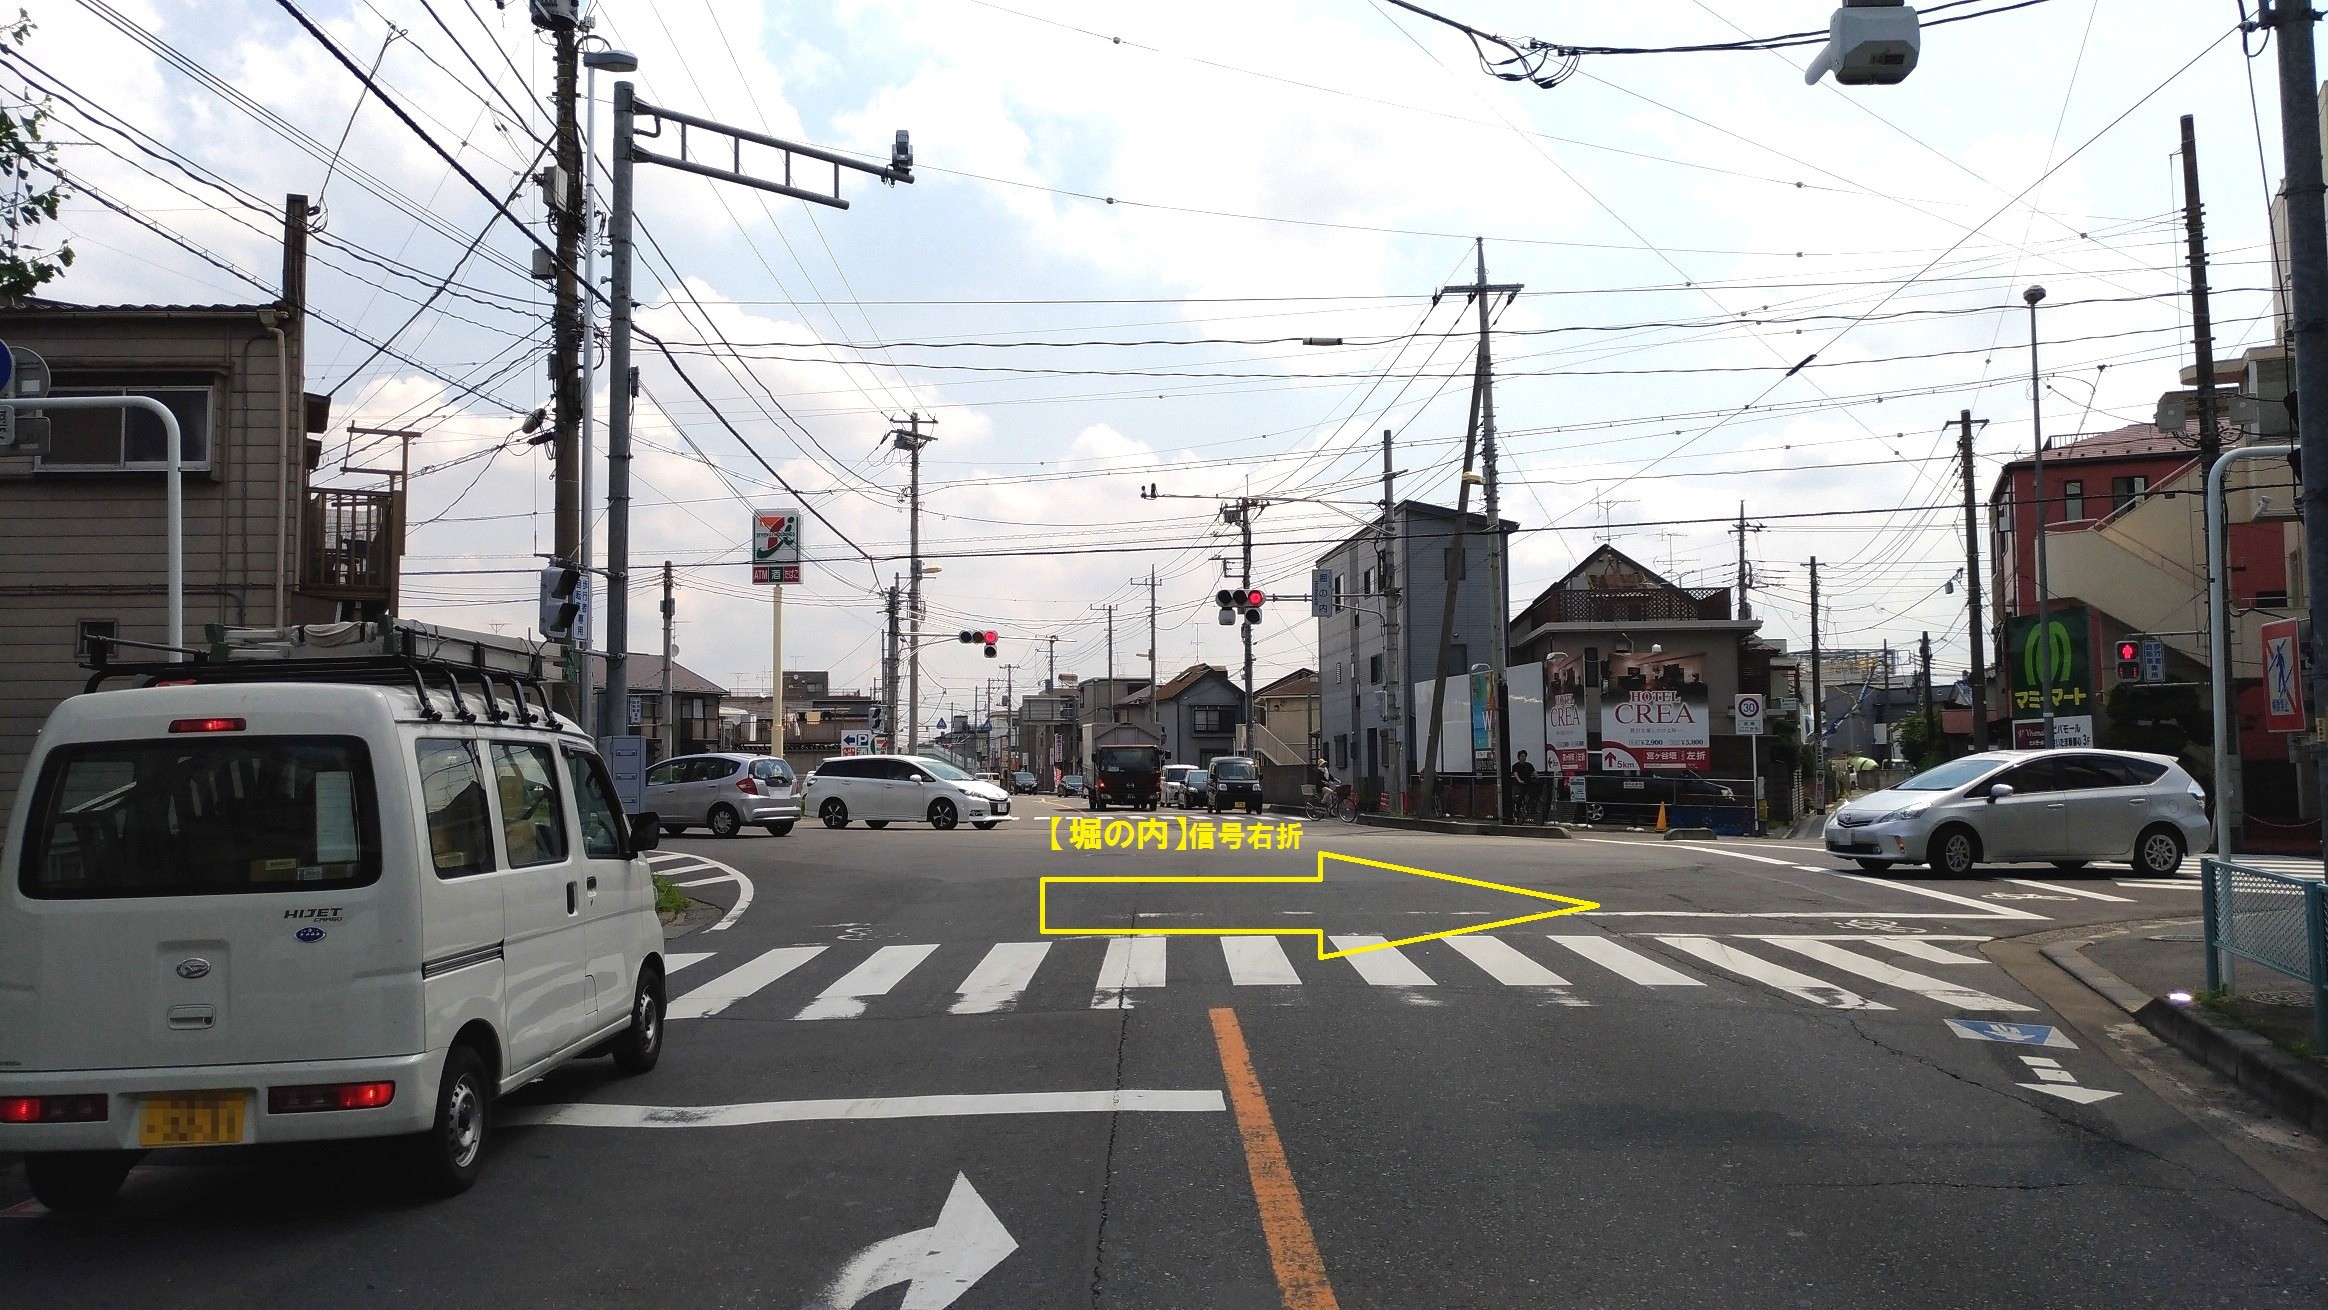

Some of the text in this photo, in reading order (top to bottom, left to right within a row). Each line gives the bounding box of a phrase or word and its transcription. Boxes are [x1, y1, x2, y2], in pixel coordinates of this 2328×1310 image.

[754, 569, 768, 580] ATM
[771, 569, 781, 580] 酒
[784, 569, 799, 579] たばこ
[1319, 573, 1328, 613] 堀の内
[577, 614, 584, 636] 専用
[1629, 690, 1682, 704] HOTEL
[1743, 703, 1755, 712] 30
[1550, 706, 1581, 728] CREA
[1614, 703, 1696, 724] CREA
[858, 735, 867, 746] P
[1686, 751, 1706, 761] 左折
[1617, 760, 1635, 769] 5km
[284, 907, 343, 919] HIJET
